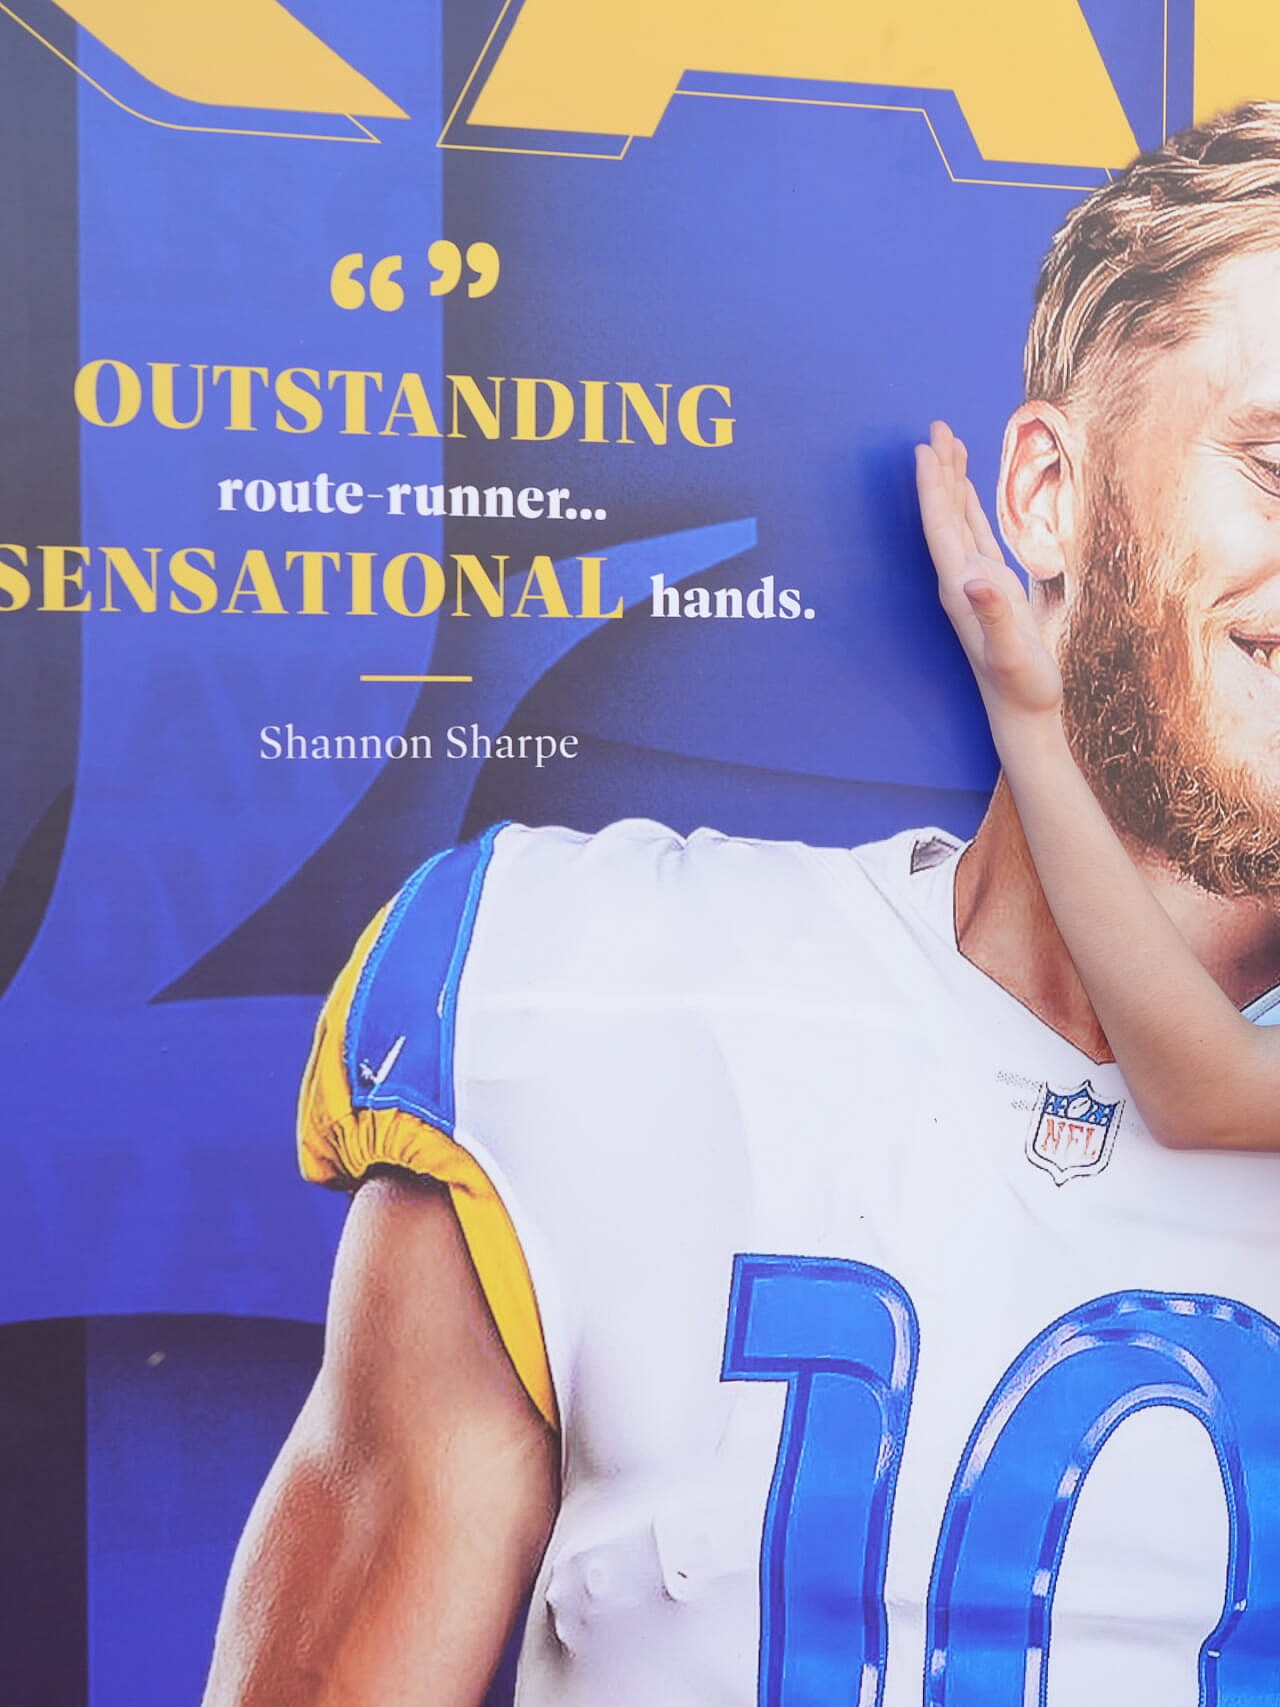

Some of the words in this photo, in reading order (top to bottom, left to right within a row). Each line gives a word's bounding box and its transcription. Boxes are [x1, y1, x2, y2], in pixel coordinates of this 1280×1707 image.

[74, 358, 736, 447] OUTSTANDING
[217, 472, 607, 521] route-runner...
[0, 543, 623, 619] SENSATIONAL
[650, 573, 816, 620] hands.
[259, 723, 433, 760] Shannon
[446, 723, 579, 768] Sharpe
[1041, 1117, 1098, 1159] NFL
